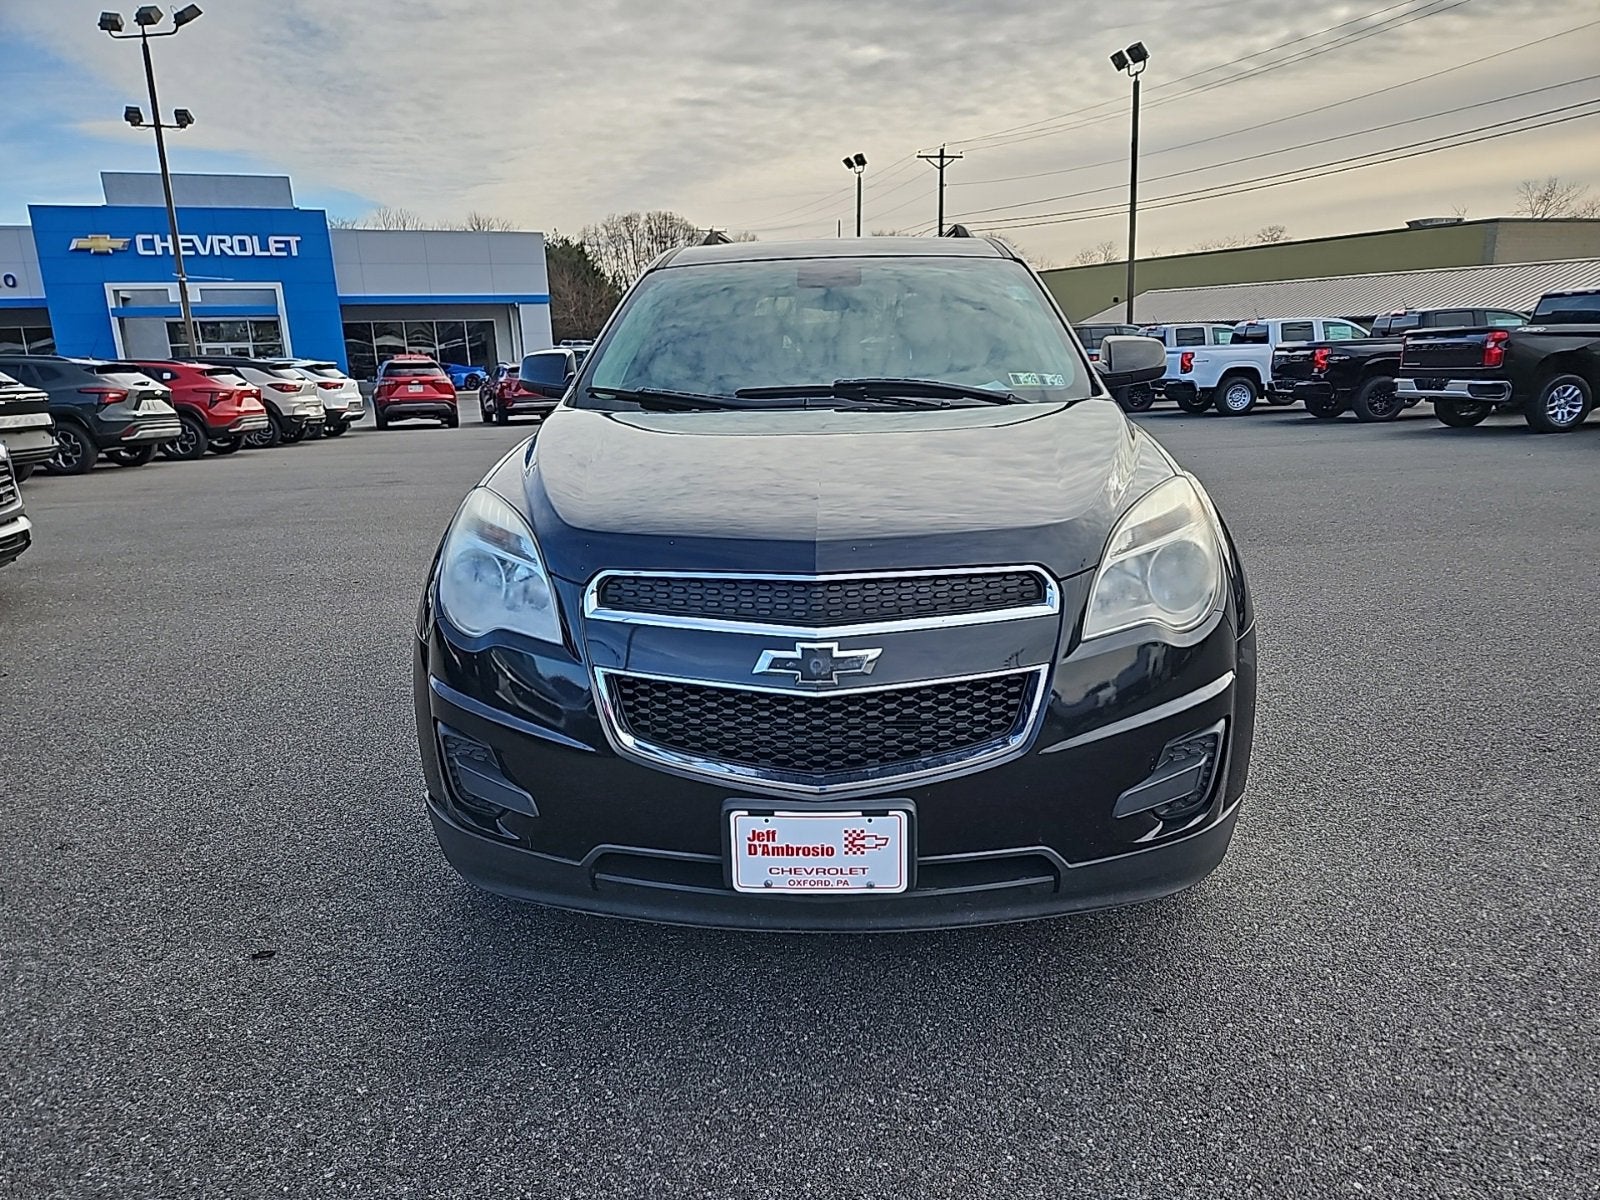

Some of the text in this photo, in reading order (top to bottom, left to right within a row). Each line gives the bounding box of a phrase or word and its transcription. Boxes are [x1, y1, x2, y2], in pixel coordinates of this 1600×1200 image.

[135, 234, 301, 256] CHEVROLET
[747, 829, 777, 842] Jeff
[747, 843, 835, 857] D'Ambrosio
[768, 867, 869, 875] CHEVROLET
[836, 879, 850, 887] PA
